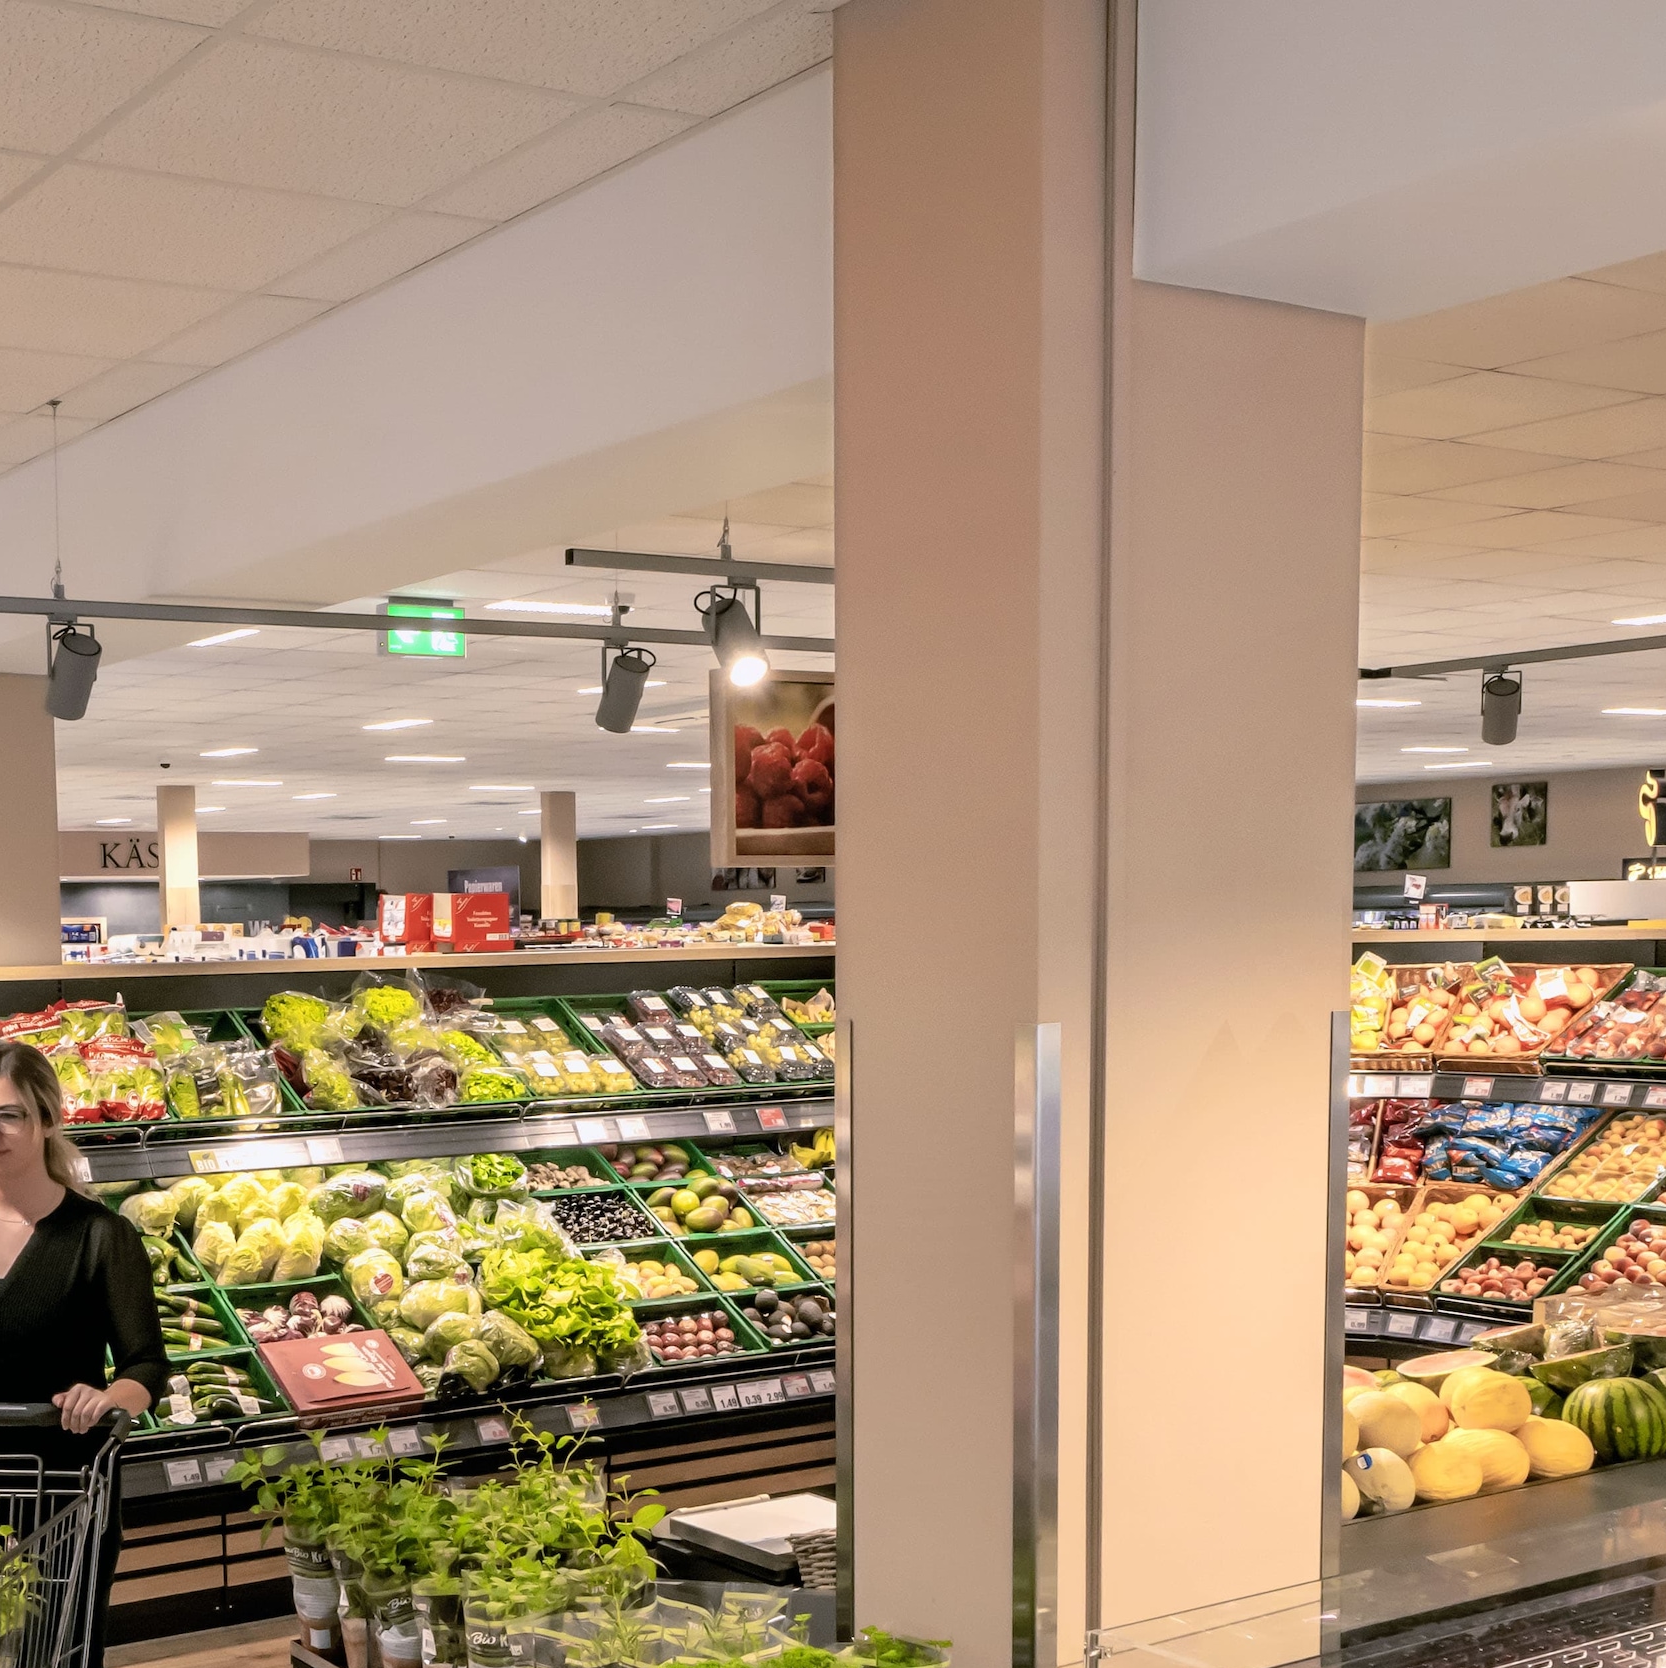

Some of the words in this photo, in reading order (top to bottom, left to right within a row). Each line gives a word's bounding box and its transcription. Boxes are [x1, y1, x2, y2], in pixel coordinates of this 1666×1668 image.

[100, 838, 160, 869] KÄS
[196, 1160, 216, 1172] BIO
[720, 1398, 737, 1409] 1.49
[745, 1395, 763, 1405] 0.39
[767, 1391, 783, 1401] 2.99
[183, 1472, 201, 1483] 1.49
[388, 1597, 412, 1609] Bio
[471, 1632, 496, 1645] Bio
